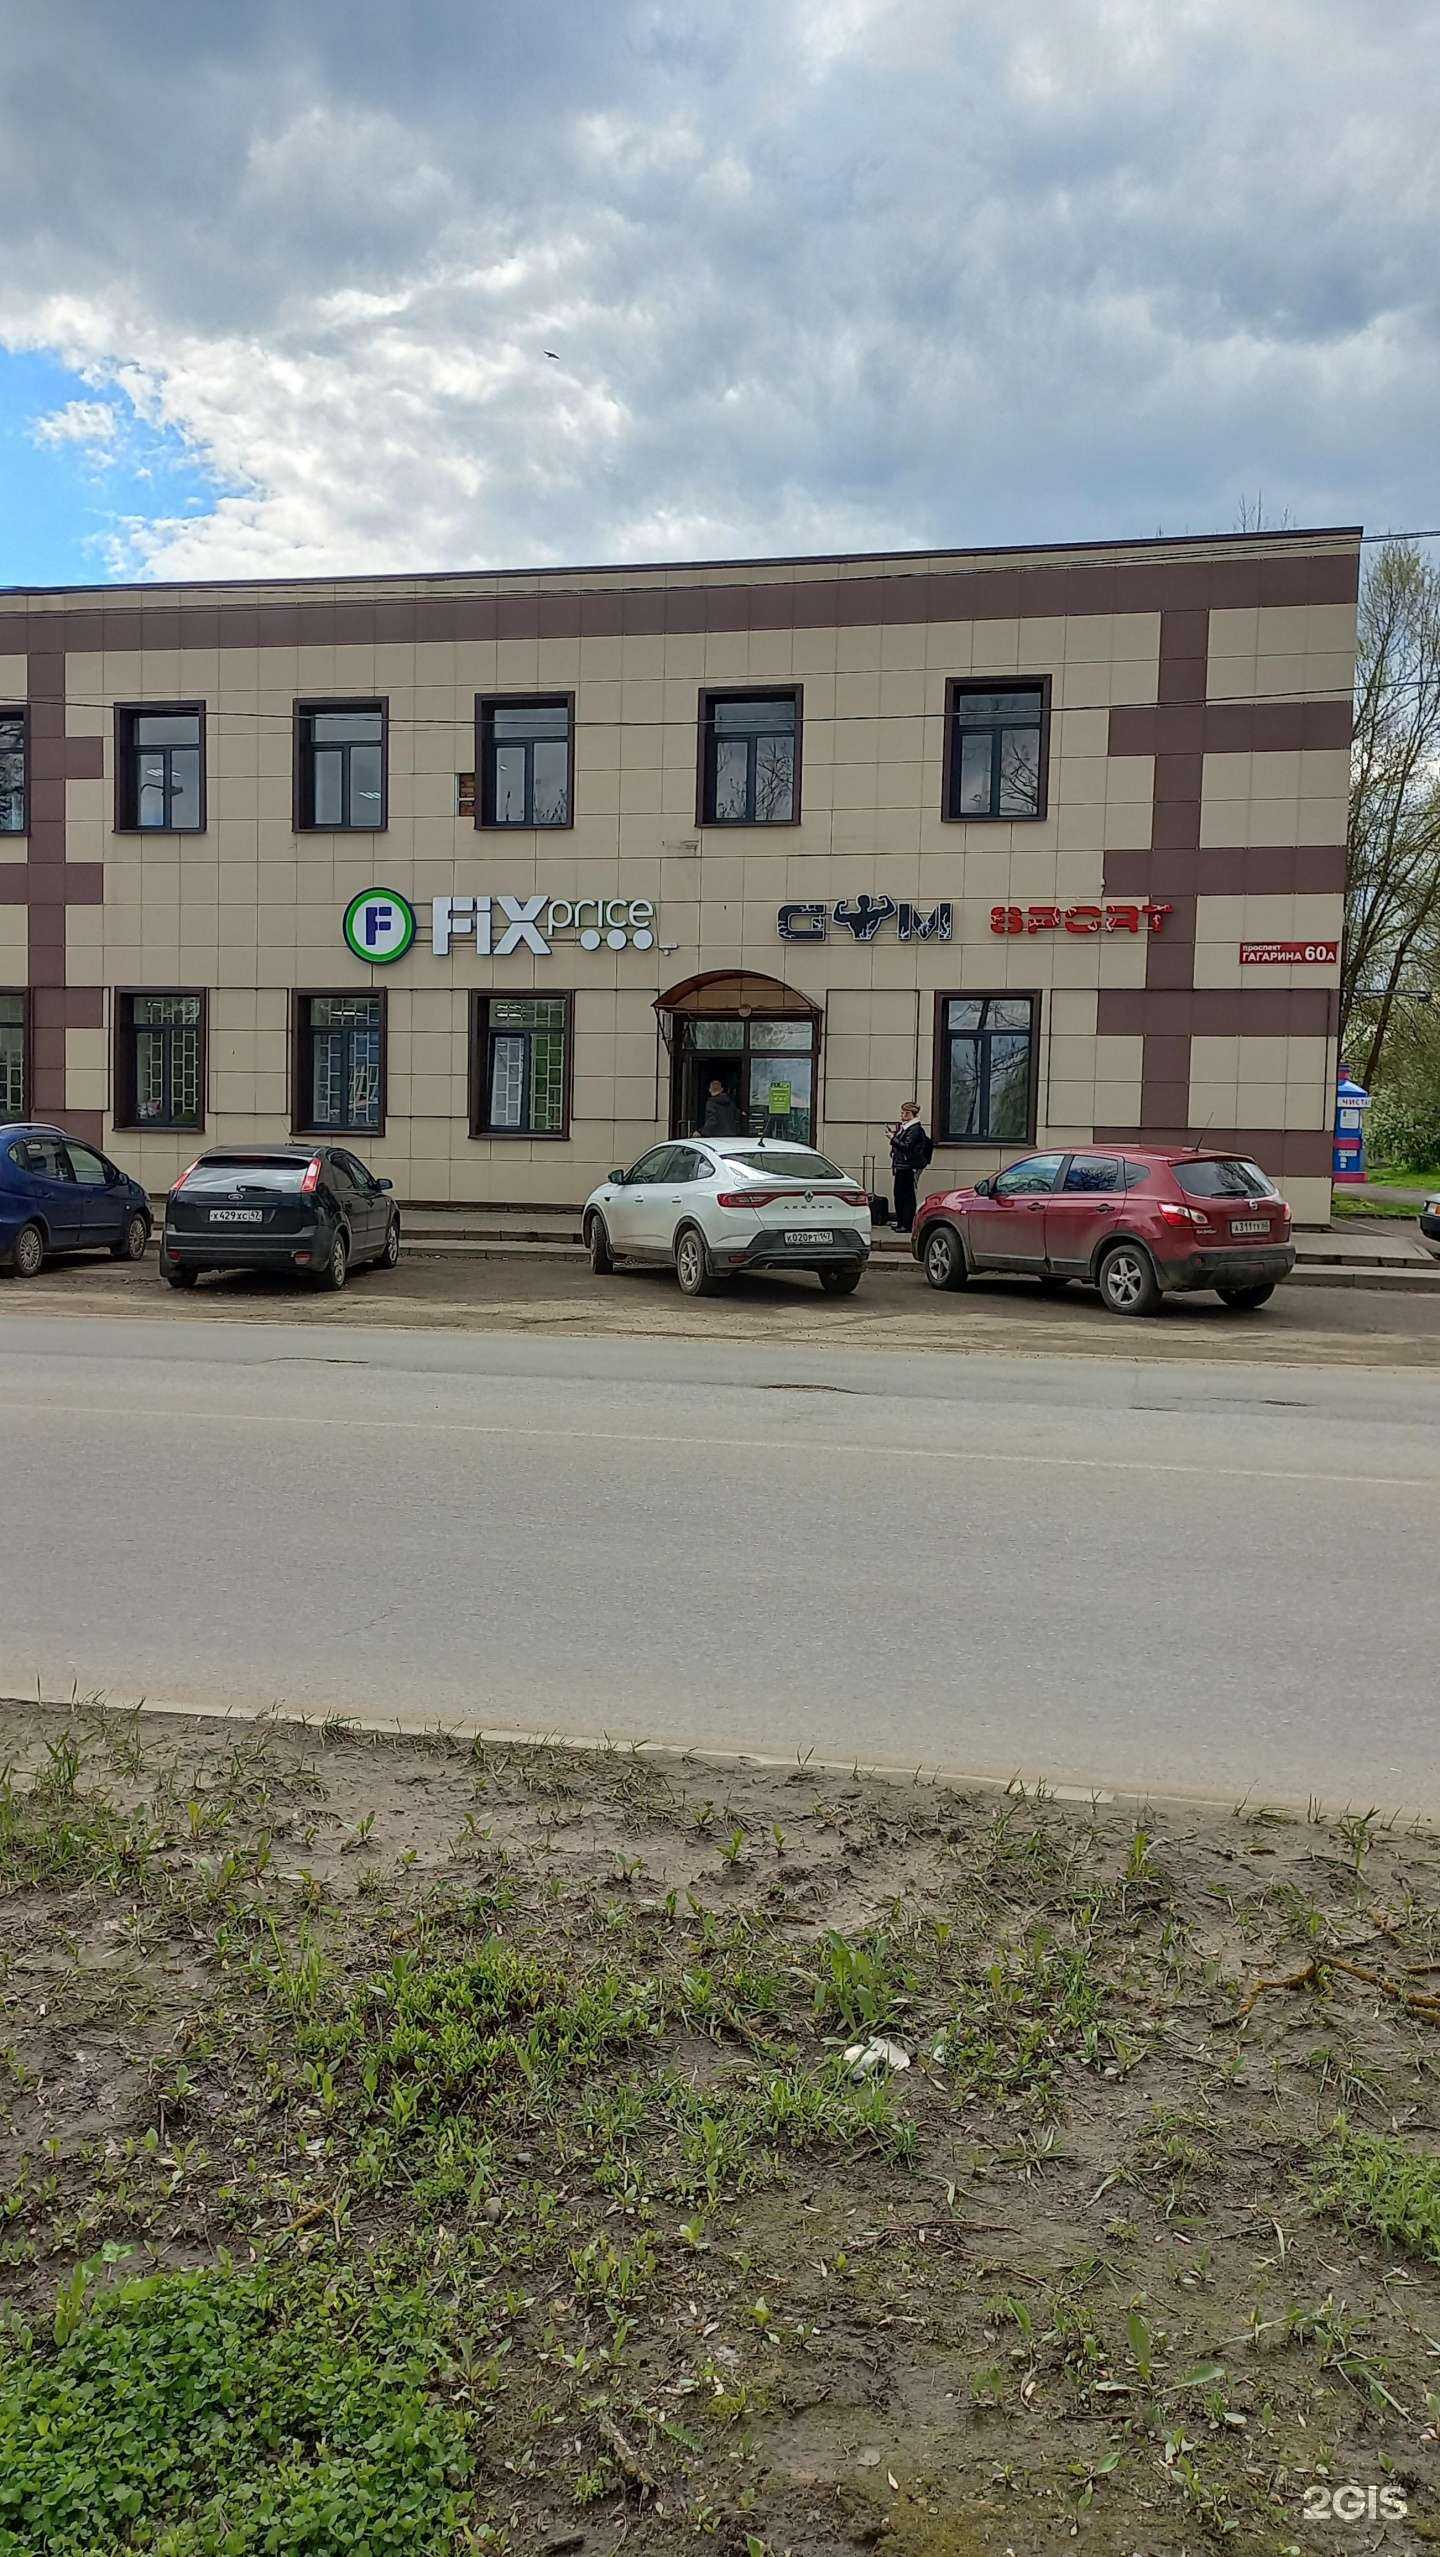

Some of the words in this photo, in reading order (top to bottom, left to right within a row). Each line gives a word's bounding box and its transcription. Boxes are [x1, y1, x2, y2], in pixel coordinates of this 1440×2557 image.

[365, 906, 393, 946] F
[548, 898, 654, 936] price
[990, 903, 1173, 934] SPORT
[1242, 951, 1303, 962] ГАГАРИНА
